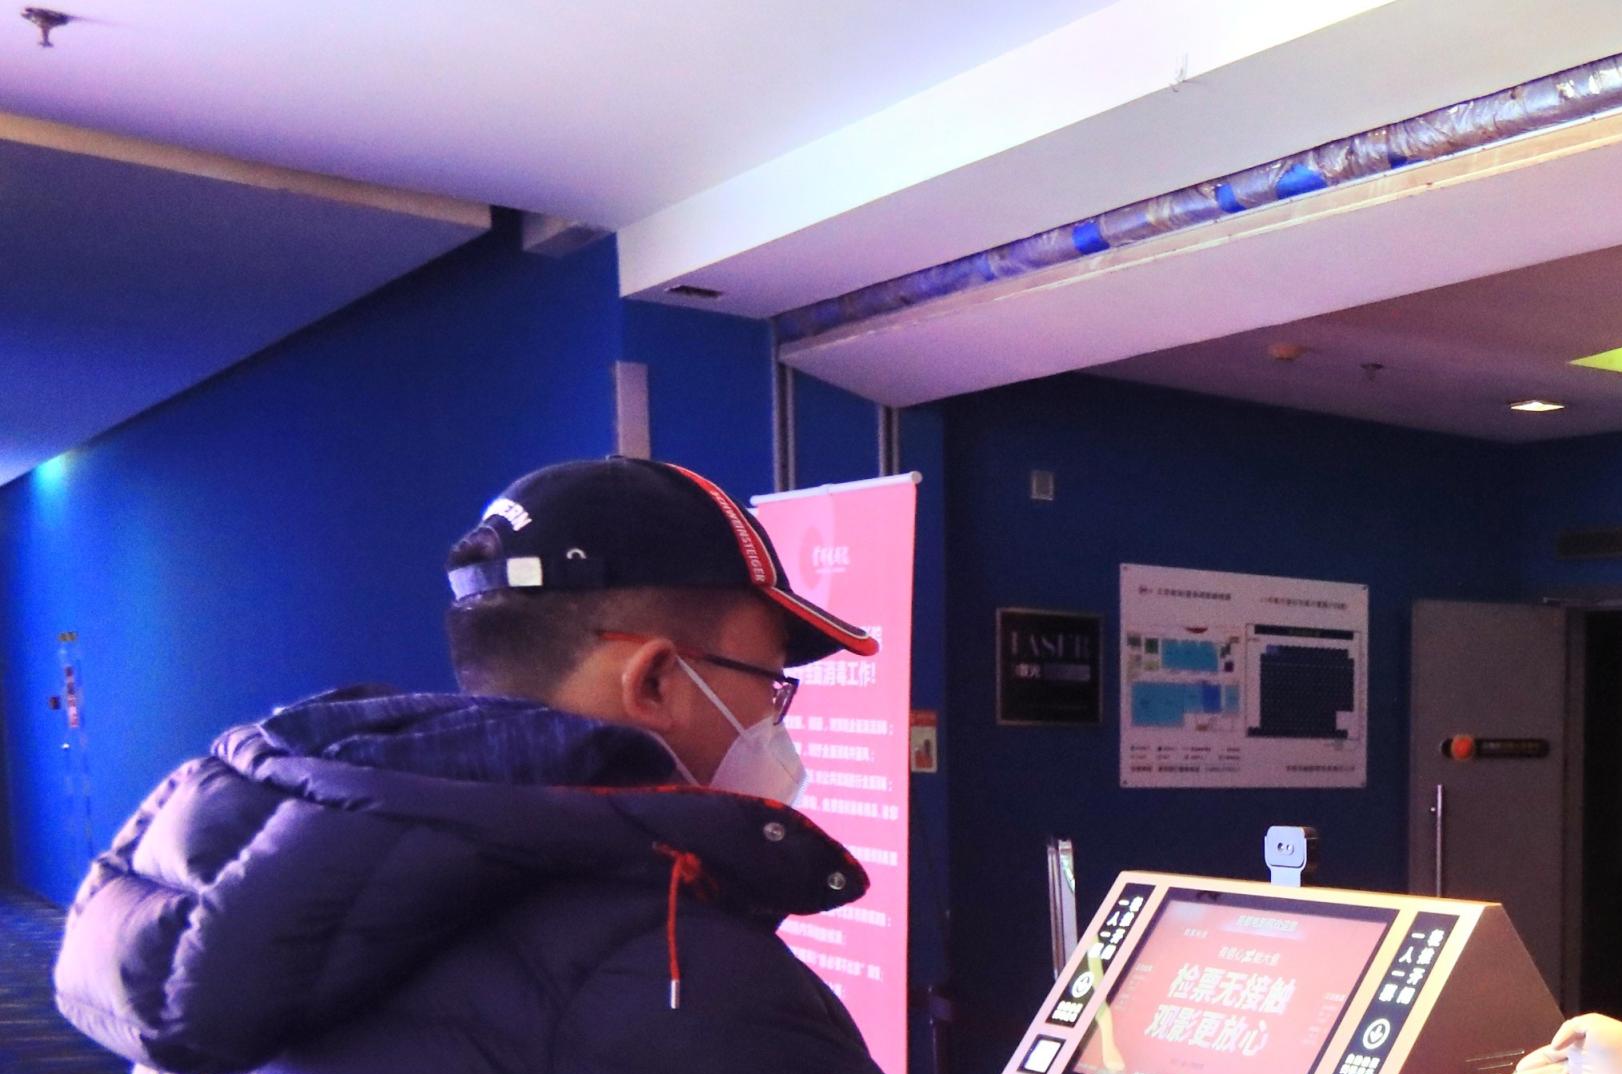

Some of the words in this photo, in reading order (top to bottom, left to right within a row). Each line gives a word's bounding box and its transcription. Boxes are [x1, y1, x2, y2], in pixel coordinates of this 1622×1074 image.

[1168, 963, 1297, 1015] 检票无接触
[1144, 1003, 1270, 1057] 观影更放心
